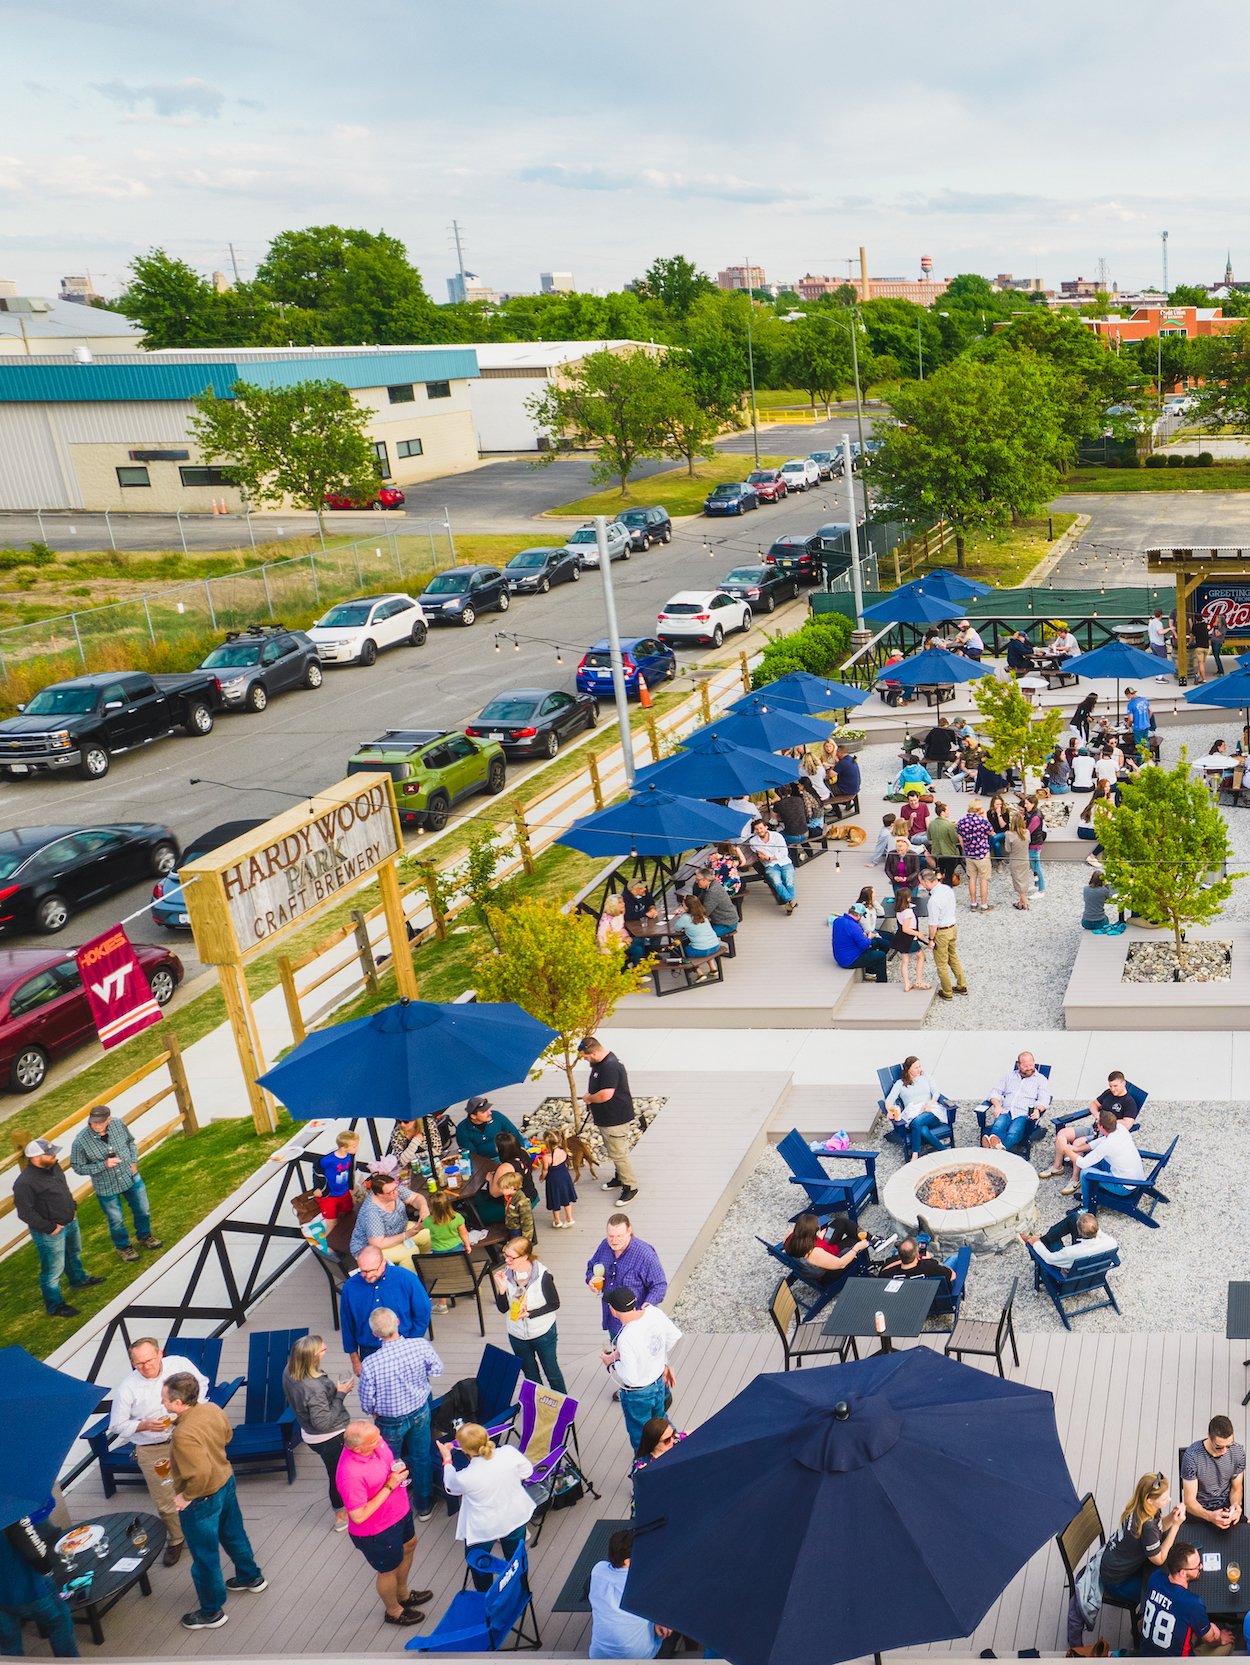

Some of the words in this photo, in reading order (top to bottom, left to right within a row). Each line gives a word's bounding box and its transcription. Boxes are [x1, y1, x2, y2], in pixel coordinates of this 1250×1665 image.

[221, 785, 385, 901] HARDYWOOD
[284, 835, 348, 896] PARK
[254, 889, 311, 939] CRAFT
[314, 841, 382, 901] BREWERY
[80, 931, 128, 969] HOKIES
[90, 961, 133, 1005] VT
[1142, 1599, 1176, 1649] 88
[1150, 1590, 1173, 1610] DAVEY
